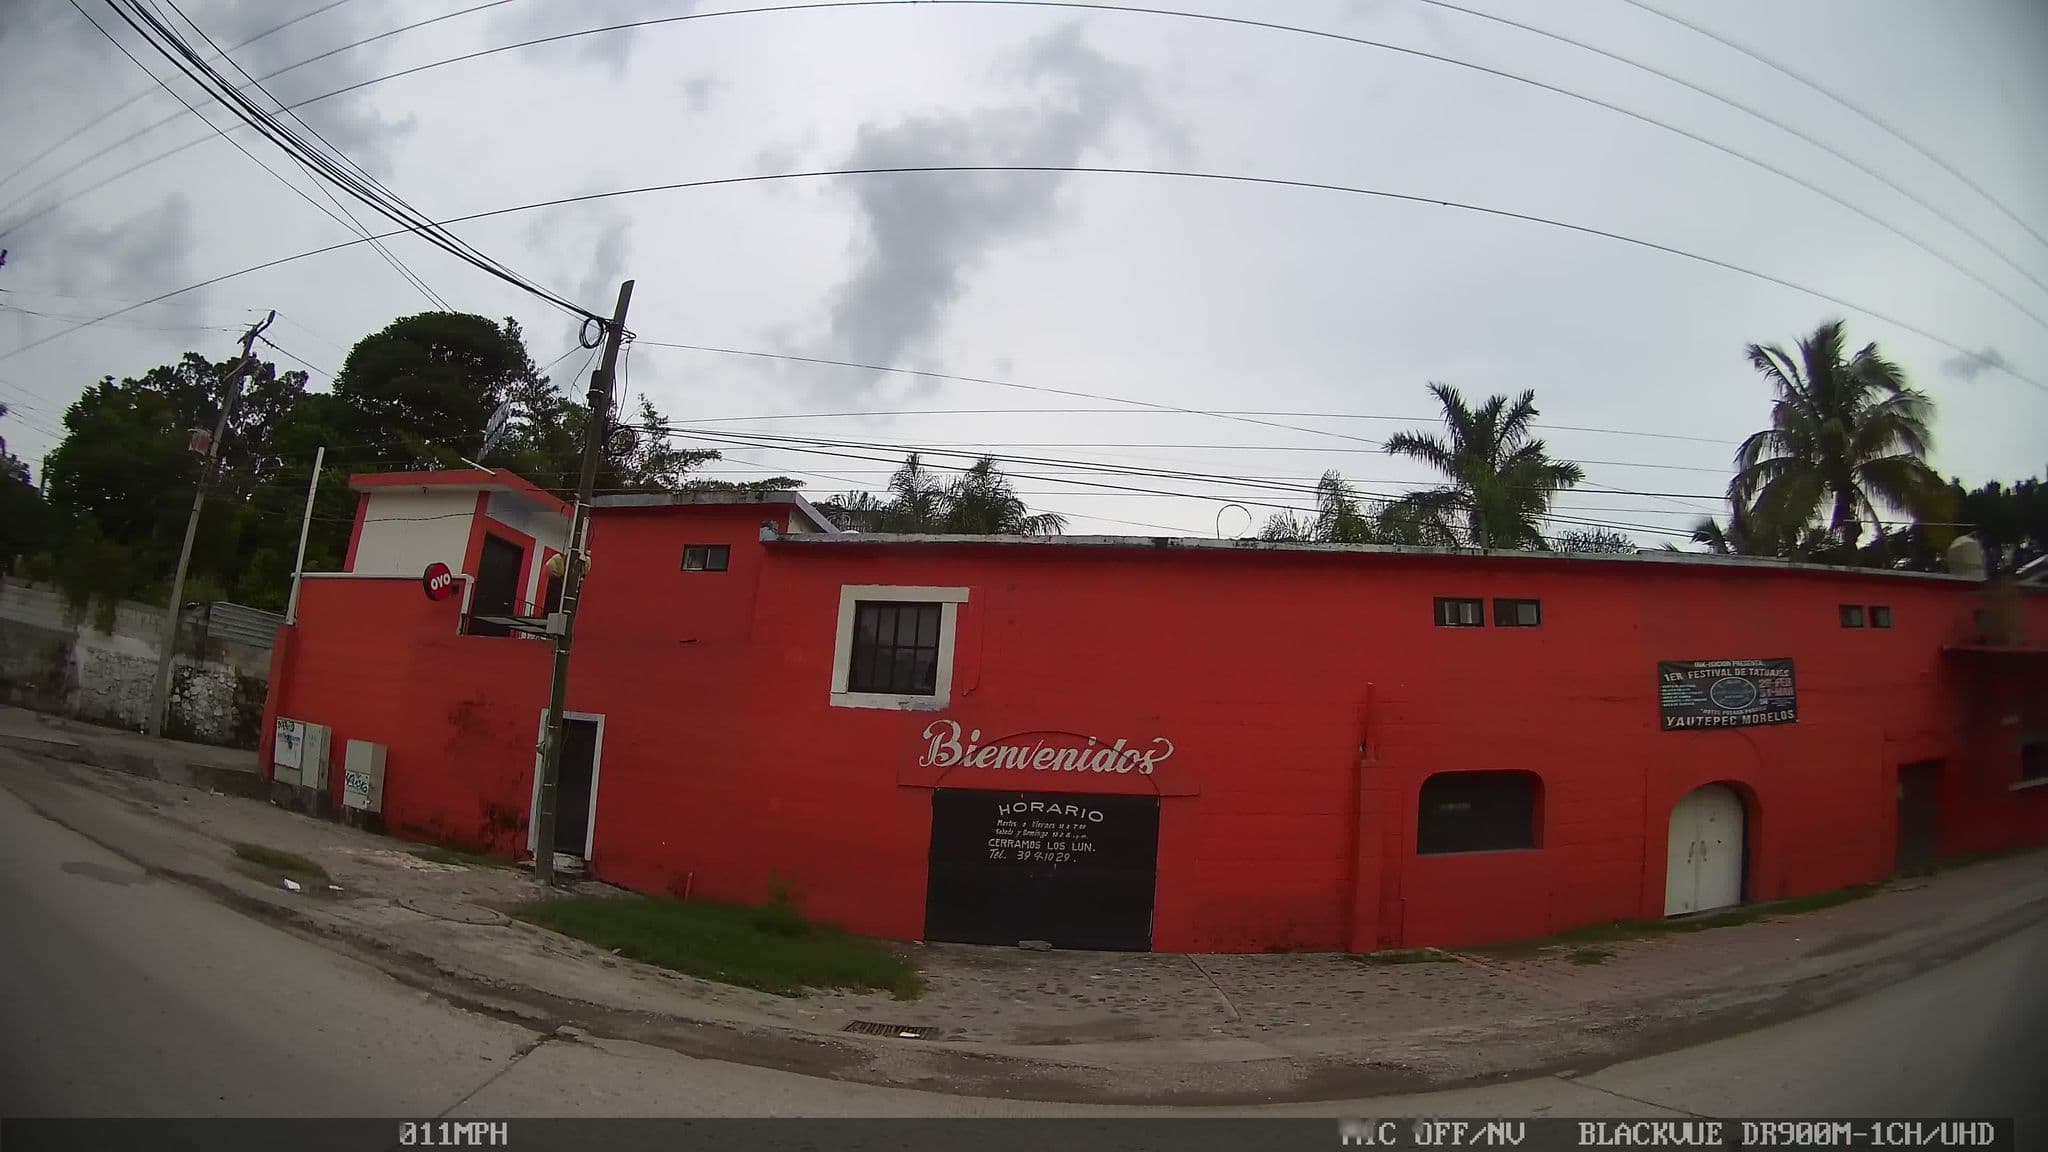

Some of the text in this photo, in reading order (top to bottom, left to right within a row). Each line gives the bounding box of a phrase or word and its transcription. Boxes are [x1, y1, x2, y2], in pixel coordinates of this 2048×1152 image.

[431, 573, 450, 590] OYO
[1664, 672, 1683, 682] 1ER
[1687, 668, 1731, 680] FESTIVAL
[1734, 668, 1748, 676] DE
[1666, 710, 1794, 726] YAUTEPEC MORELOS
[919, 719, 1174, 775] Bienvenidos
[998, 802, 1104, 822] HORARIO
[988, 838, 1096, 852] CERRAMOS LOS LUN.
[1016, 850, 1031, 860] 39
